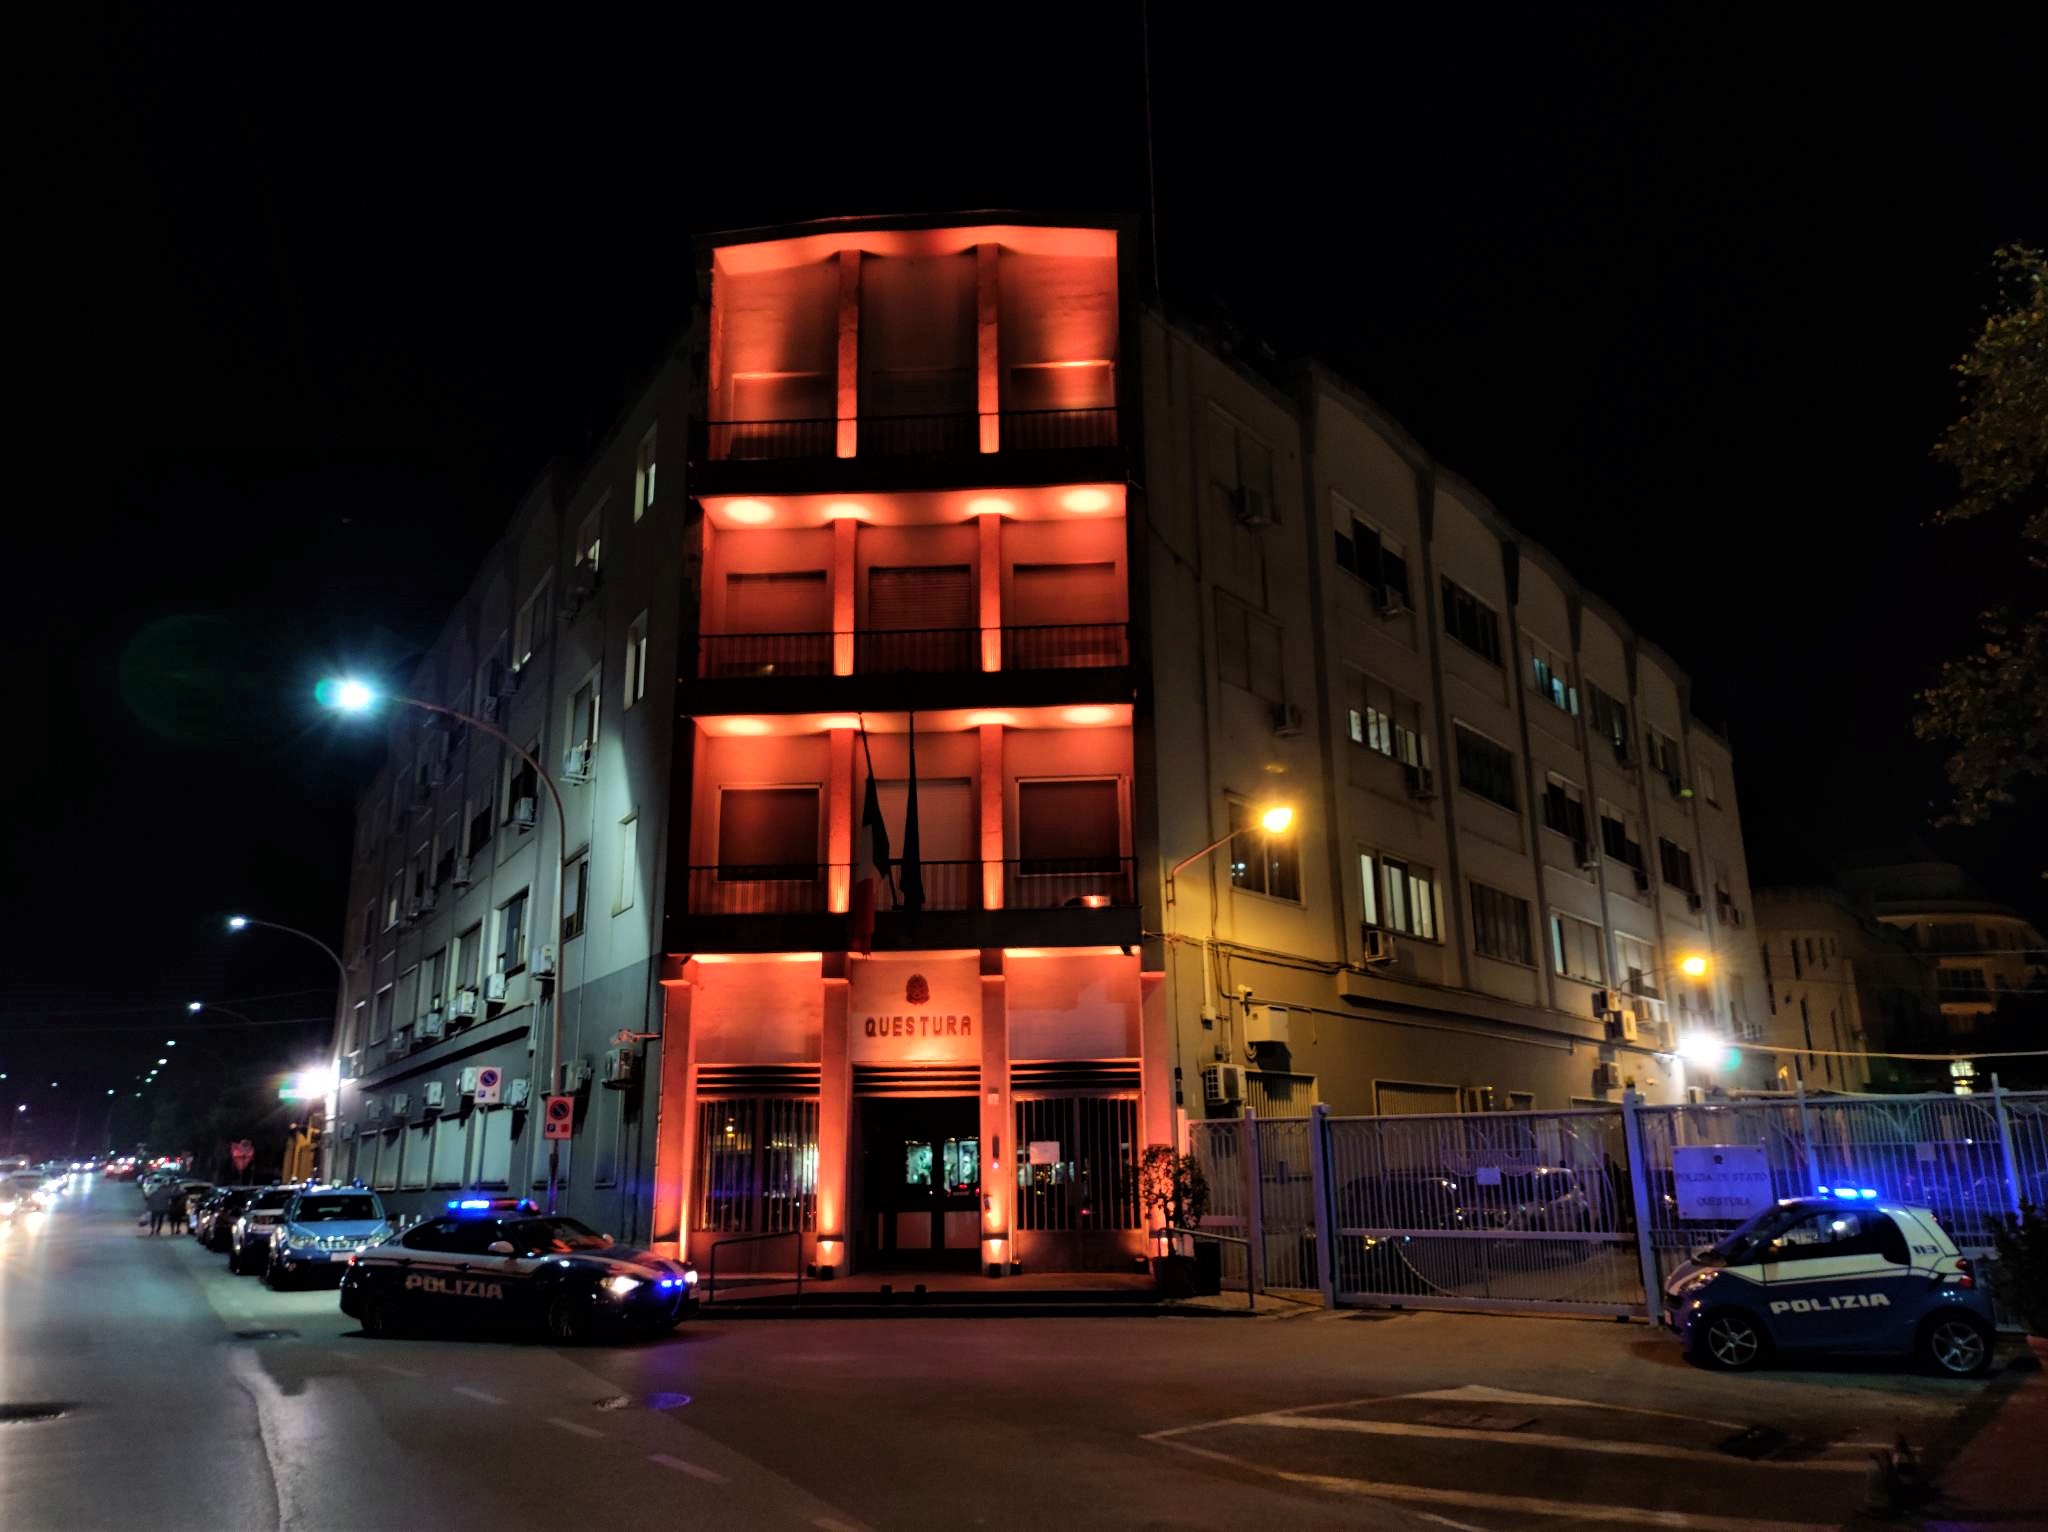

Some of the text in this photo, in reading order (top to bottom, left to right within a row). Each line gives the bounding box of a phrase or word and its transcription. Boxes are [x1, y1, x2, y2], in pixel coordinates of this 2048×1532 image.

[865, 1015, 972, 1037] QUESTURA
[1732, 1172, 1767, 1183] STATO
[1696, 1196, 1752, 1207] QUESTURA
[404, 1273, 504, 1300] POLIZIA
[1769, 1292, 1891, 1315] POLIZIA
